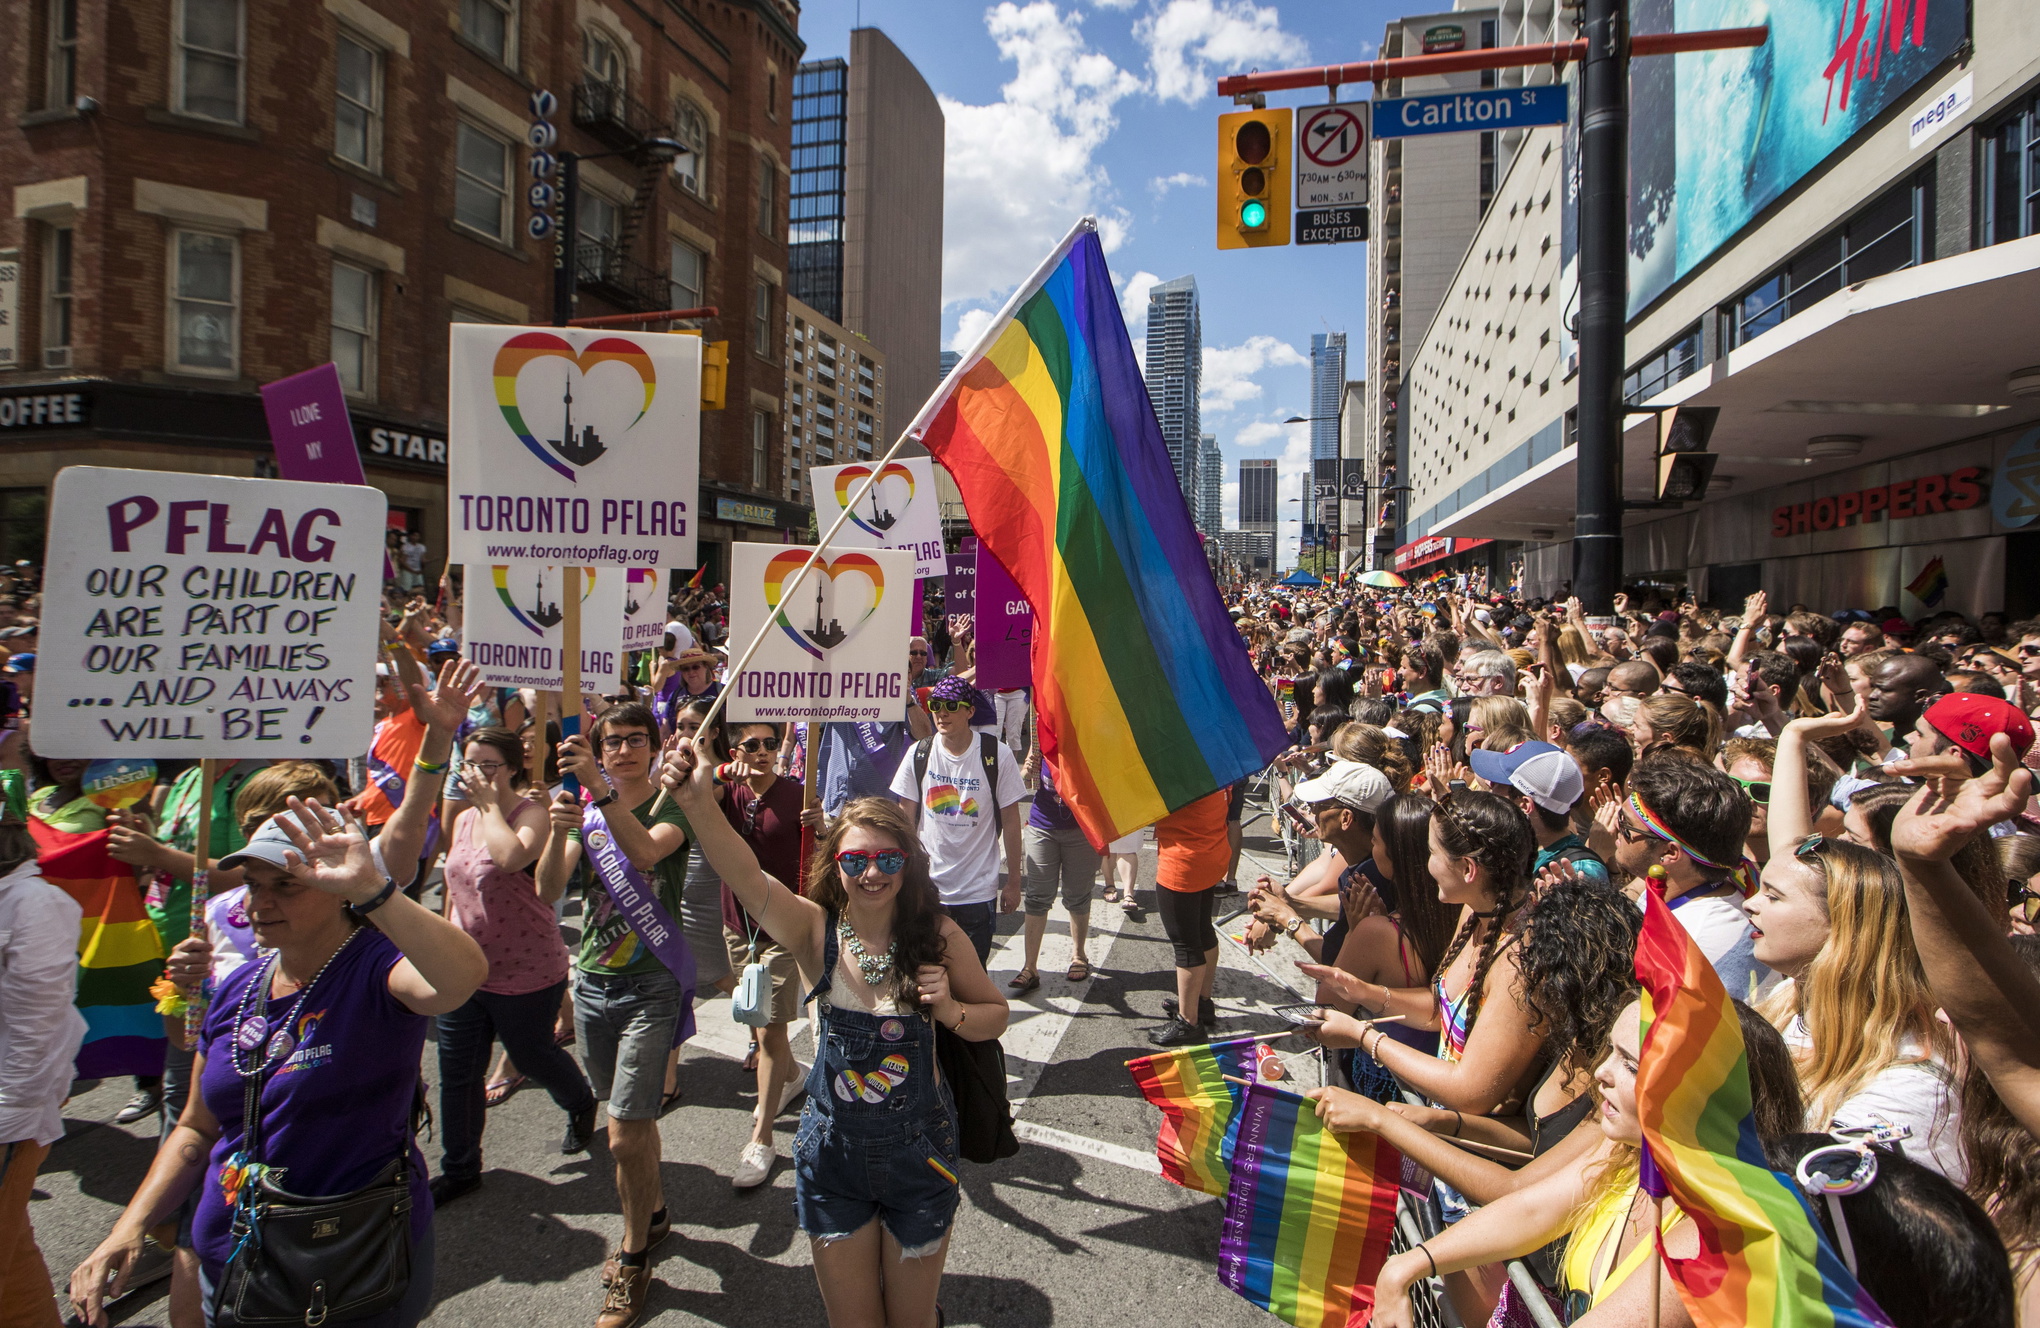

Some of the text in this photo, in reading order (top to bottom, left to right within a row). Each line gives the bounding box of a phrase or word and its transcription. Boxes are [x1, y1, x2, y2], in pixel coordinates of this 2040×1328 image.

[1401, 91, 1537, 127] Carlton St
[1911, 92, 1957, 136] mega
[1313, 211, 1351, 226] BUSES
[1303, 226, 1362, 241] EXCEPTED
[0, 394, 83, 427] OFFEE
[299, 402, 322, 426] LOVE
[305, 440, 324, 461] MY
[369, 427, 447, 464] STAR
[743, 504, 775, 520] RITZ
[1771, 467, 1981, 538] SHOPPERS
[459, 494, 687, 537] TORONTO PFLAG
[106, 495, 342, 563] PFLAG
[487, 544, 659, 564] www.torontopflag.org
[898, 541, 942, 561] LAG
[85, 564, 356, 601] OUR CHILDREN
[955, 566, 976, 575] Pro
[955, 590, 967, 599] of
[1005, 600, 1031, 615] GAY
[85, 603, 338, 638] ARE PART OF
[636, 622, 664, 639] PFLAG
[82, 642, 331, 674] OUR FAMILIES
[469, 641, 613, 675] TORONTO LAG
[228, 677, 353, 703] ALWAYS
[486, 673, 596, 691] www.torontopflorg
[736, 671, 902, 698] TORONTO PFLAG
[755, 705, 881, 719] www.torontopflag.org
[100, 716, 205, 743] WILL
[858, 722, 877, 749] PFLAG
[93, 766, 150, 791] Liberal
[928, 770, 958, 785] POSITIVE
[596, 843, 670, 947] TORONTO PFLAG
[305, 1044, 332, 1060] PFLAG
[886, 1061, 905, 1073] TEASE
[847, 1079, 858, 1090] BI
[868, 1077, 886, 1093] QUEEN
[1243, 1105, 1265, 1173] WINNERS
